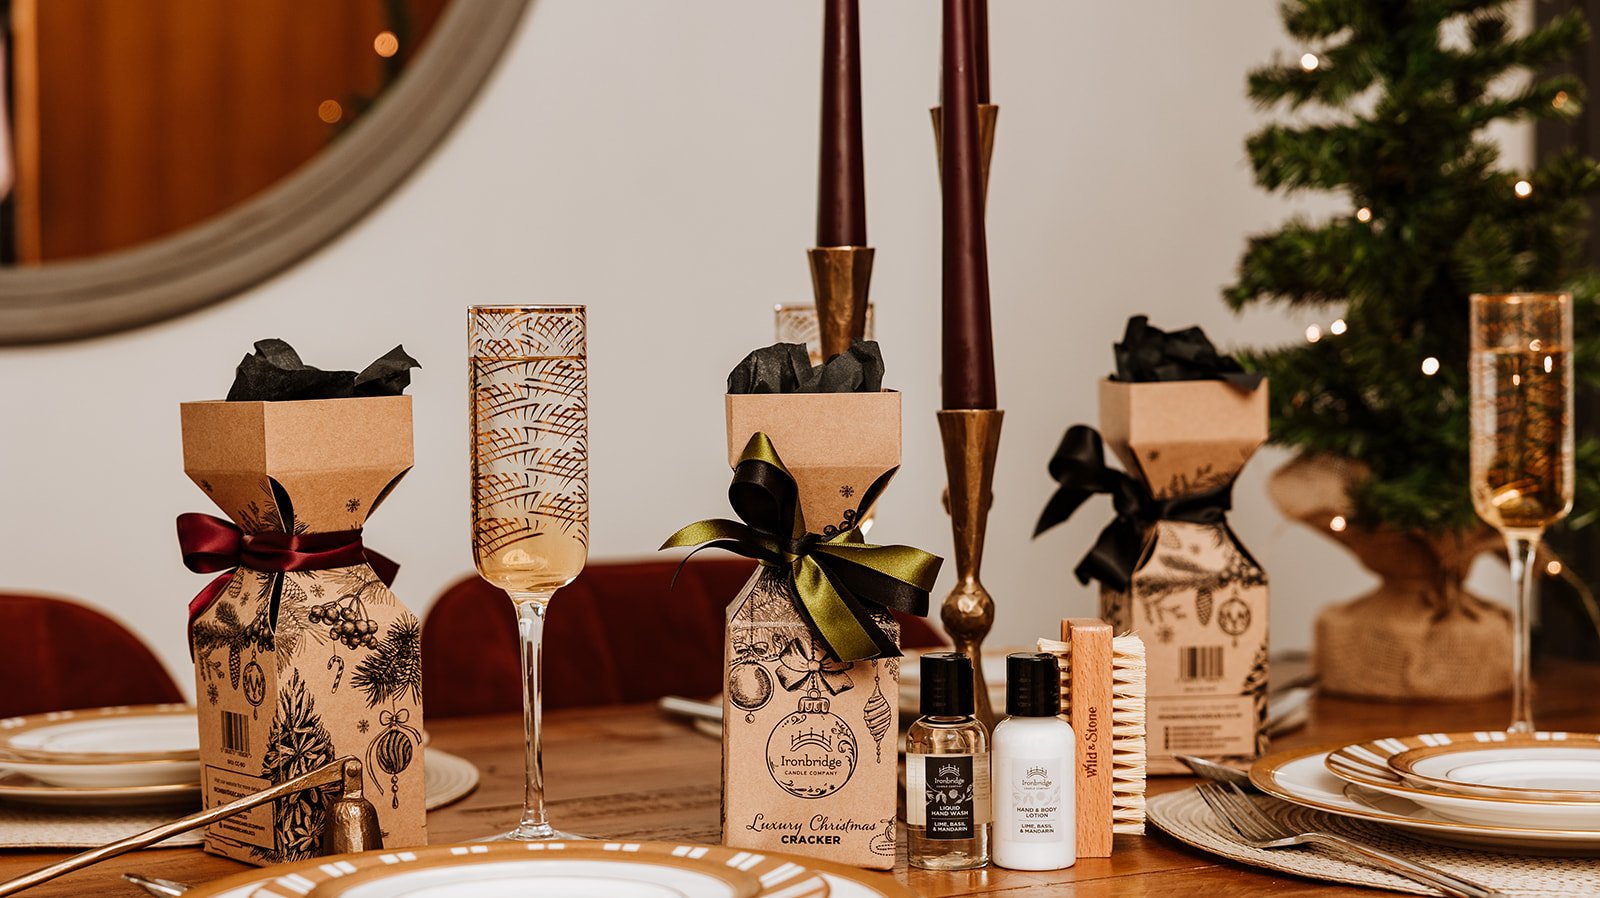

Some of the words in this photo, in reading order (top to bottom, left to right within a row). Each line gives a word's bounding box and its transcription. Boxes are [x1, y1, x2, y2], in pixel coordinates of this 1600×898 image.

[1085, 706, 1098, 743] Stone
[1088, 743, 1096, 751] &
[781, 754, 842, 769] Ironbridge
[1082, 752, 1098, 778] Wild
[746, 813, 802, 836] Luxury
[810, 814, 877, 833] Christmas
[781, 835, 841, 844] CRACKER
